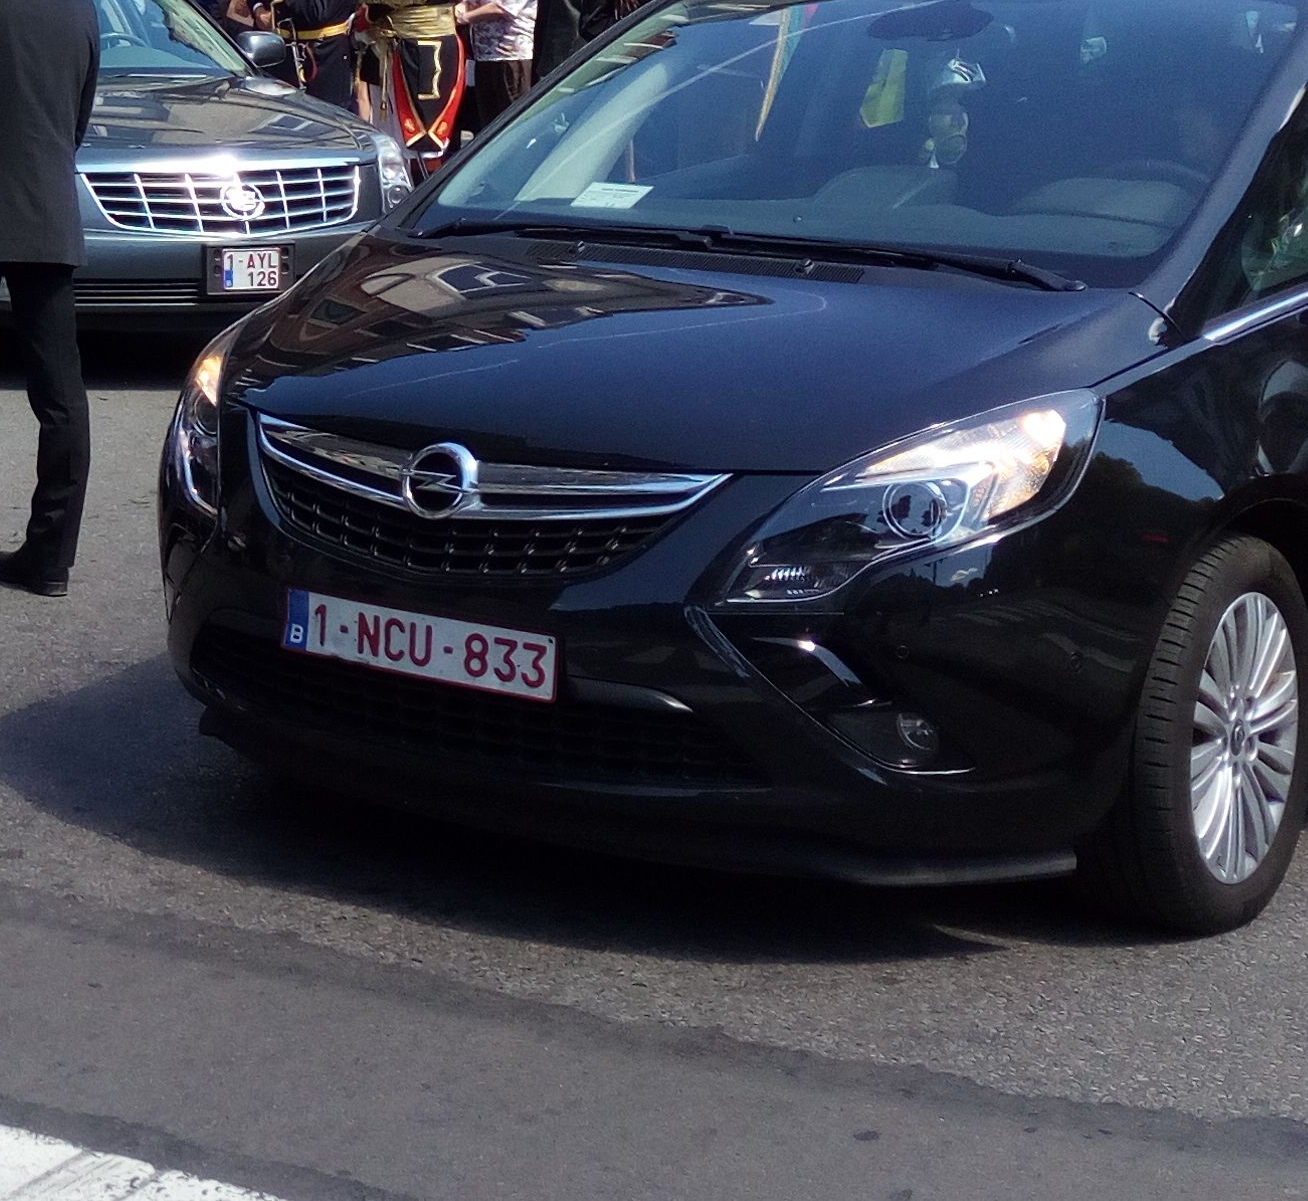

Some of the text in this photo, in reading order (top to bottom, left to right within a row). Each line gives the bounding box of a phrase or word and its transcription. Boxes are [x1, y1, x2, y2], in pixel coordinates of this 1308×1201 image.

[227, 252, 278, 269] 1-AYL
[247, 271, 277, 286] 126
[289, 623, 304, 643] B
[314, 603, 547, 688] 1-NCU-833
